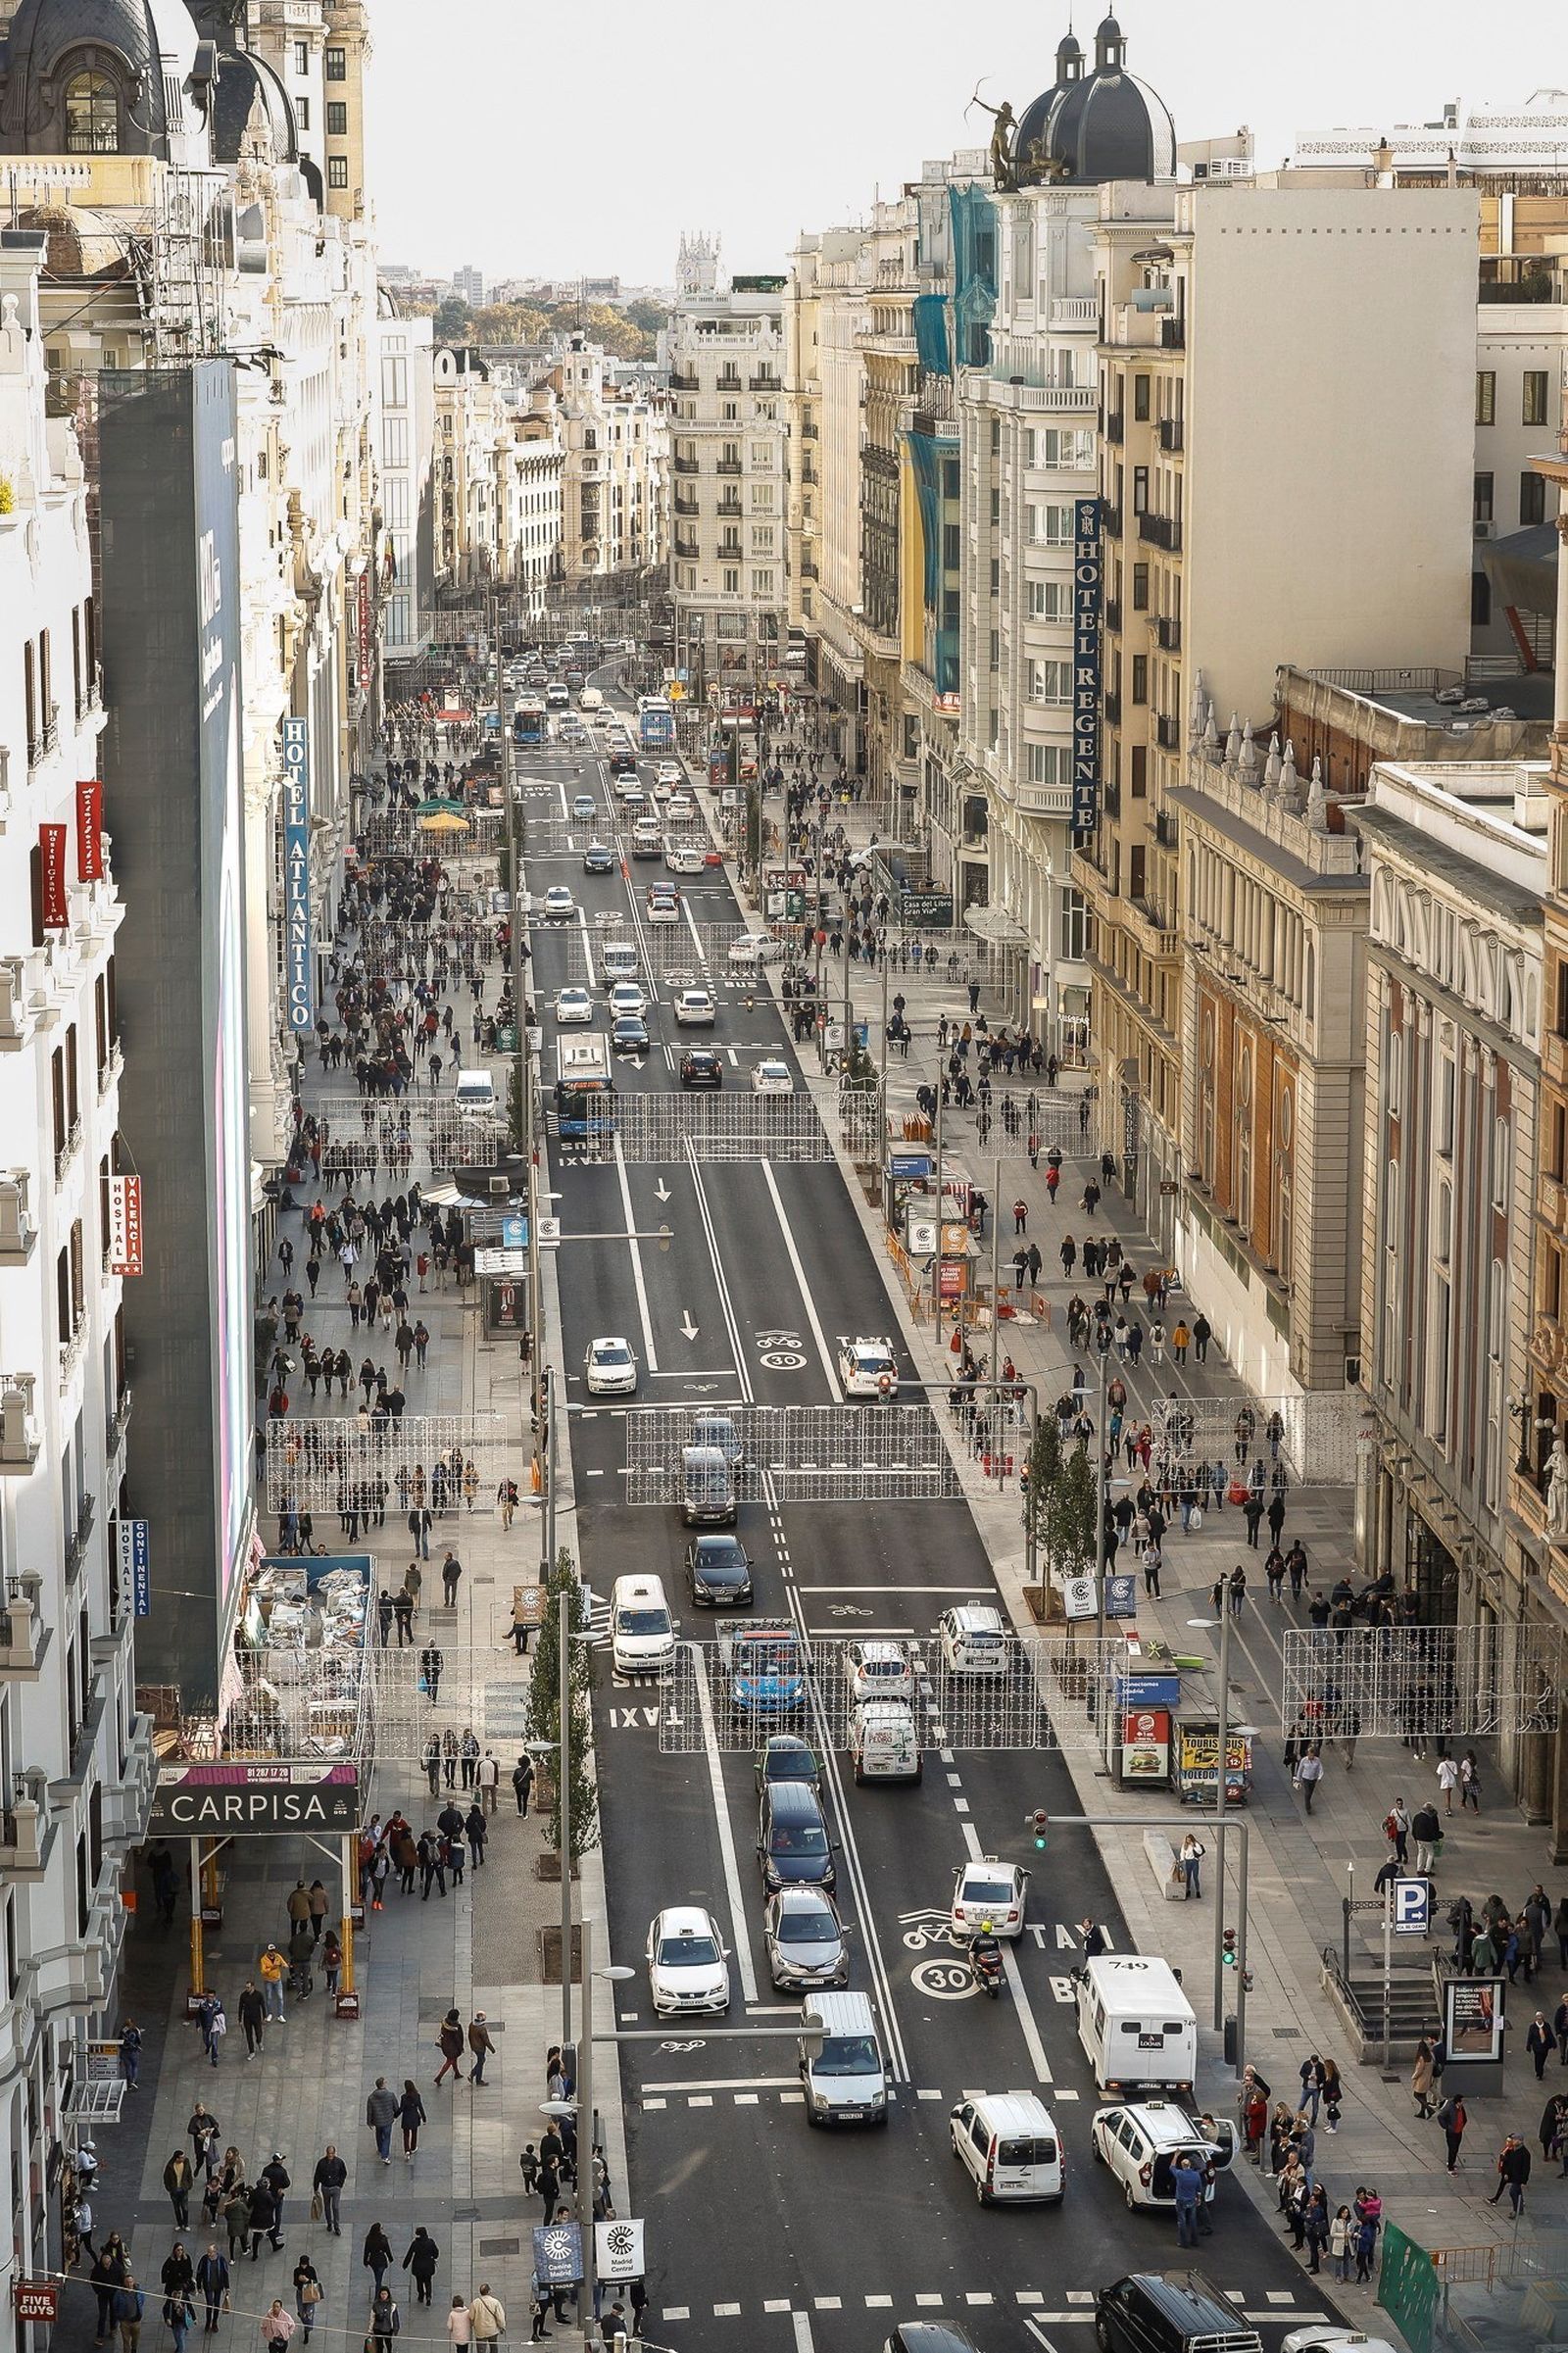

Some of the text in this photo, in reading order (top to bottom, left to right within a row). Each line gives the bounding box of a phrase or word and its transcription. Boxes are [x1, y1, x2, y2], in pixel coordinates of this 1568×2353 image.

[360, 581, 368, 620] PETIT
[1074, 540, 1098, 828] HOTEL REGENTE
[48, 829, 59, 867] Hostal
[47, 868, 57, 893] Gran
[285, 721, 310, 1026] HOTEL ATLANTICO
[45, 913, 65, 923] 44
[561, 1141, 601, 1151] BUS
[558, 1155, 605, 1167] TAXI
[114, 1184, 123, 1256] HOSTAL
[127, 1178, 139, 1262] VALENCIA
[771, 1355, 796, 1365] 30
[122, 1524, 130, 1586] HOSTAL
[136, 1522, 146, 1615] CONTINENTAL
[609, 1706, 684, 1728] TAXI
[1183, 1770, 1215, 1780] TOLEDO
[171, 1794, 327, 1823] CARPISA
[1396, 1884, 1427, 1922] P
[927, 1968, 968, 1989] 30
[1108, 1961, 1150, 1971] 749
[20, 2305, 55, 2316] GUYS
[22, 2295, 51, 2306] FIVE
